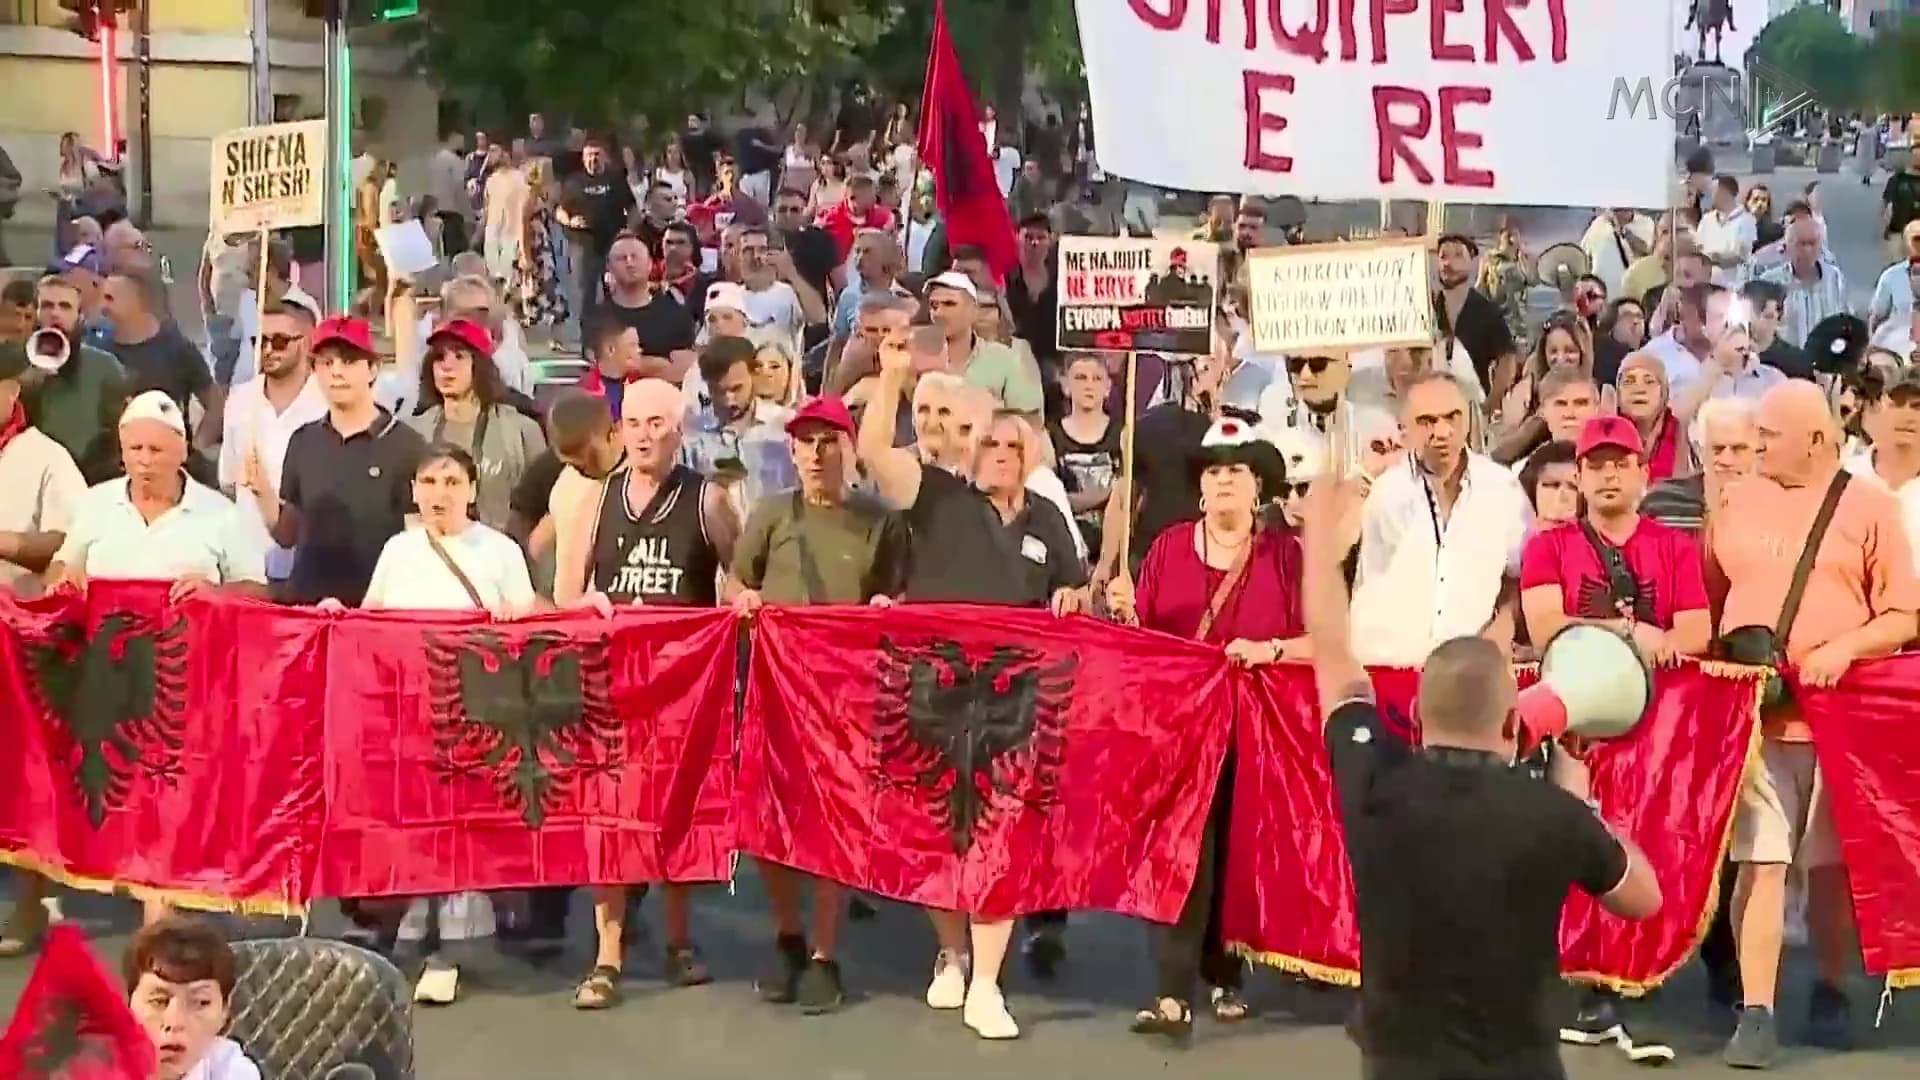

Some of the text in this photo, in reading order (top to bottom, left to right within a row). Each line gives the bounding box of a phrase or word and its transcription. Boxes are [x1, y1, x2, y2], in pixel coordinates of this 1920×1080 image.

[1243, 69, 1495, 189] E RE
[1065, 250, 1087, 271] ME
[1065, 307, 1122, 332] EVROPA
